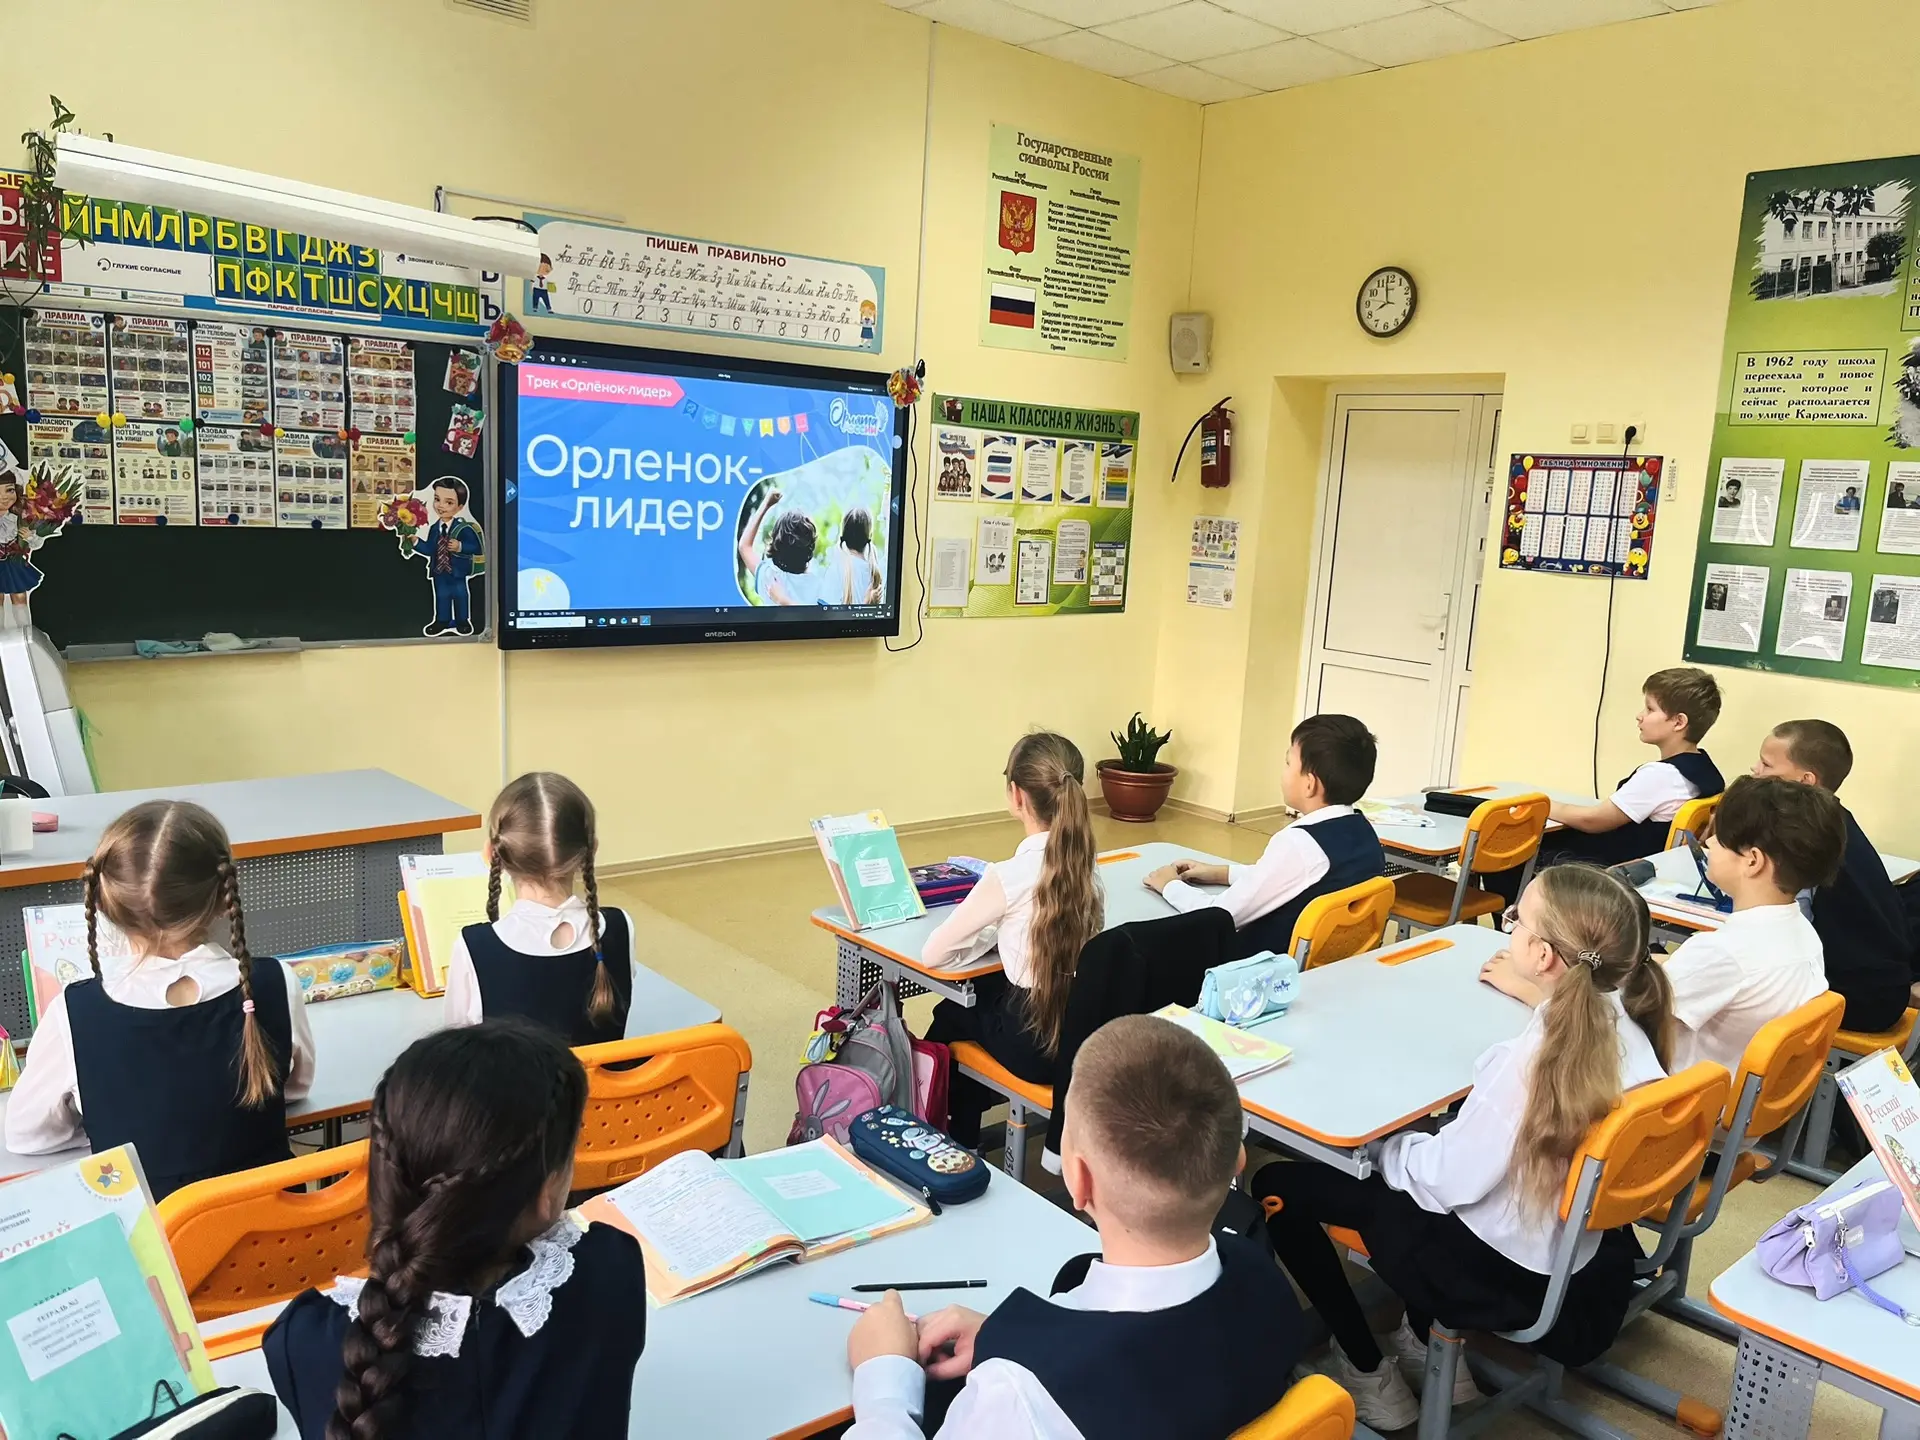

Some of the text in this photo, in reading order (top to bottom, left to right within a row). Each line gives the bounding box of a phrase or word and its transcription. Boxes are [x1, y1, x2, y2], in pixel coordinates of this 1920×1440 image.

[1017, 132, 1113, 166] Государственные
[1018, 152, 1110, 181] символы России
[646, 236, 787, 267] ПИШЕМ ПРАВИЛЬНО
[112, 262, 182, 275] ГЛУХИЕ СОГЛАСНЫЕ
[1376, 279, 1384, 288] 11
[1386, 274, 1396, 284] 12
[1398, 278, 1402, 286] 1
[1369, 288, 1378, 298] 10
[1404, 286, 1410, 296] 2
[1364, 300, 1370, 308] 9
[1406, 298, 1412, 306] 3
[267, 304, 335, 316] ПАРНЫЕ СОГЛАСНЫЕ
[1366, 310, 1373, 320] 8
[1401, 308, 1406, 318] 4
[44, 312, 86, 322] ПРАВИЛА
[583, 298, 841, 342] 0 1 2 3 4 5 6 7 8 9 10
[1394, 318, 1399, 326] 5
[132, 318, 170, 328] ПРАВИЛА
[1374, 319, 1380, 328] 7
[1383, 322, 1388, 330] 6
[290, 333, 328, 344] ПРАВИЛА
[364, 340, 399, 349] ПРАВИЛА
[197, 348, 210, 356] 112
[198, 360, 211, 369] 101
[1747, 356, 1876, 368] В 1962 году школа
[198, 374, 212, 382] 102
[1744, 372, 1802, 382] переехала
[199, 386, 212, 394] 103
[526, 374, 672, 399] Трек «Орлёнок-лидер»
[1802, 385, 1849, 394] которое
[200, 398, 213, 406] 104
[1742, 397, 1870, 408] сейчас располагается
[971, 402, 1116, 434] НАША КЛАССНАЯ ЖИЗНЬ
[1757, 412, 1790, 420] улице
[1796, 408, 1868, 420] Кармелюка.
[40, 418, 74, 426] ОПАСНОСТЬ
[366, 438, 400, 446] ПРАВИЛА
[526, 433, 763, 489] Орленок-
[1539, 458, 1630, 470] ТАБЛИЦА УМНОЖЕНИЯ
[569, 497, 724, 540] лидер
[1864, 1094, 1901, 1124] Русский
